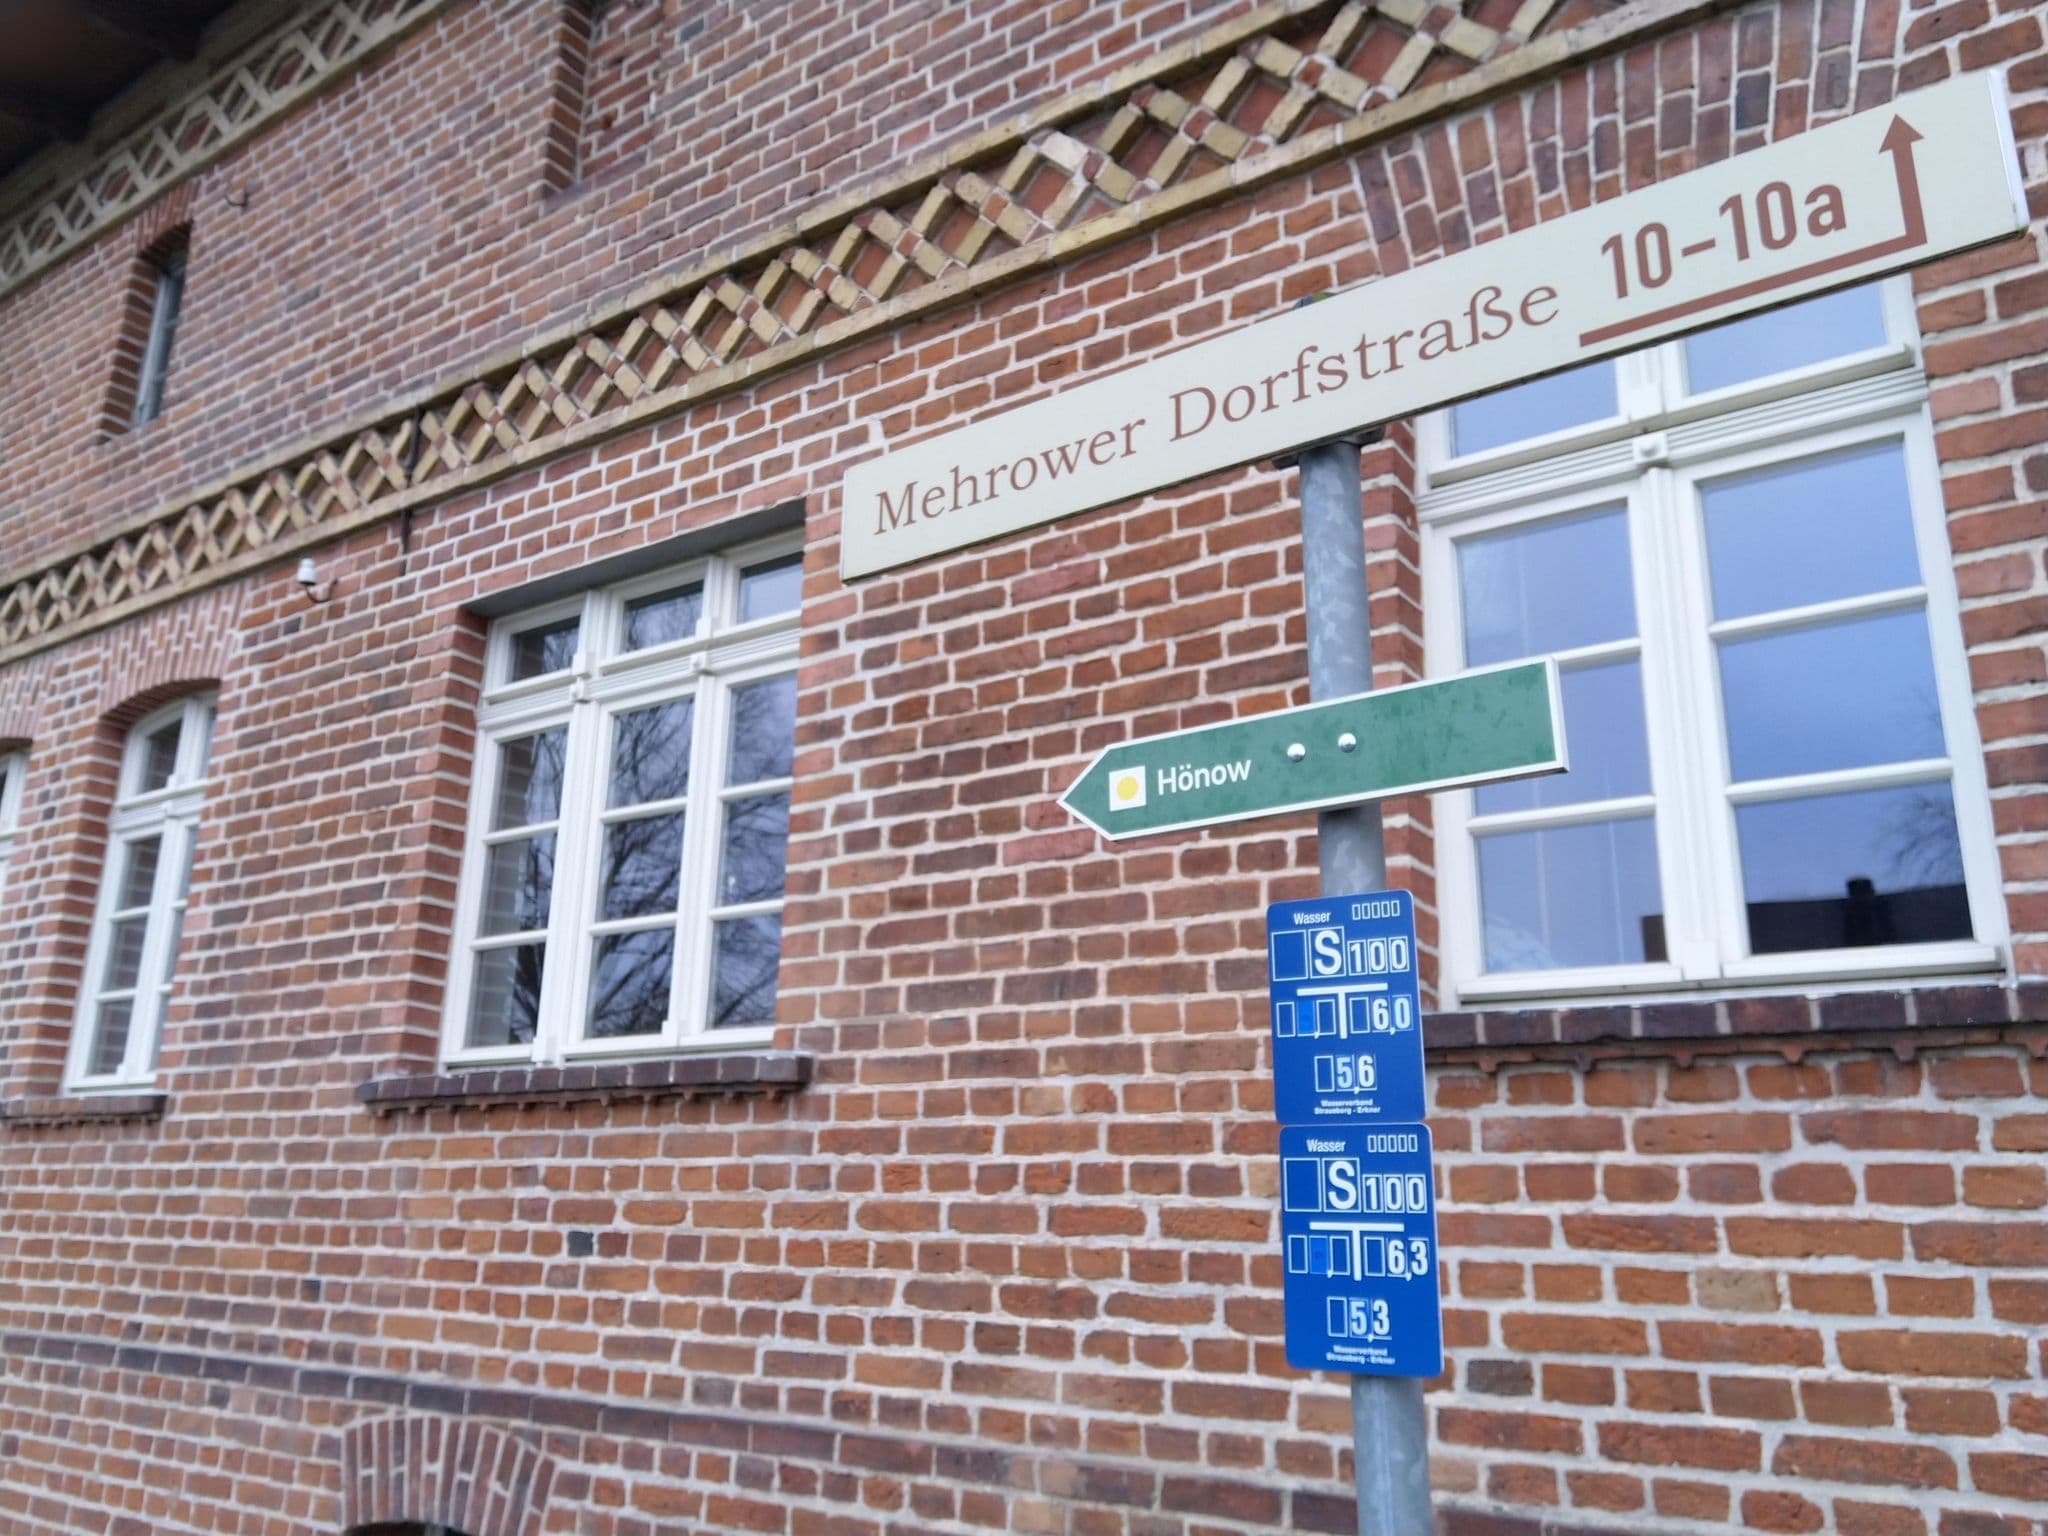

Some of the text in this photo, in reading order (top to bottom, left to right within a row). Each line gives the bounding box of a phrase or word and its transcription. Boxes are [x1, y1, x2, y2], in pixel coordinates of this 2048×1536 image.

[873, 417, 1147, 536] Mehrower
[1168, 284, 1560, 442] Dorfstraße
[1157, 759, 1252, 796] Hönow
[1293, 911, 1331, 925] Wasser
[1306, 1139, 1346, 1152] Wasser
